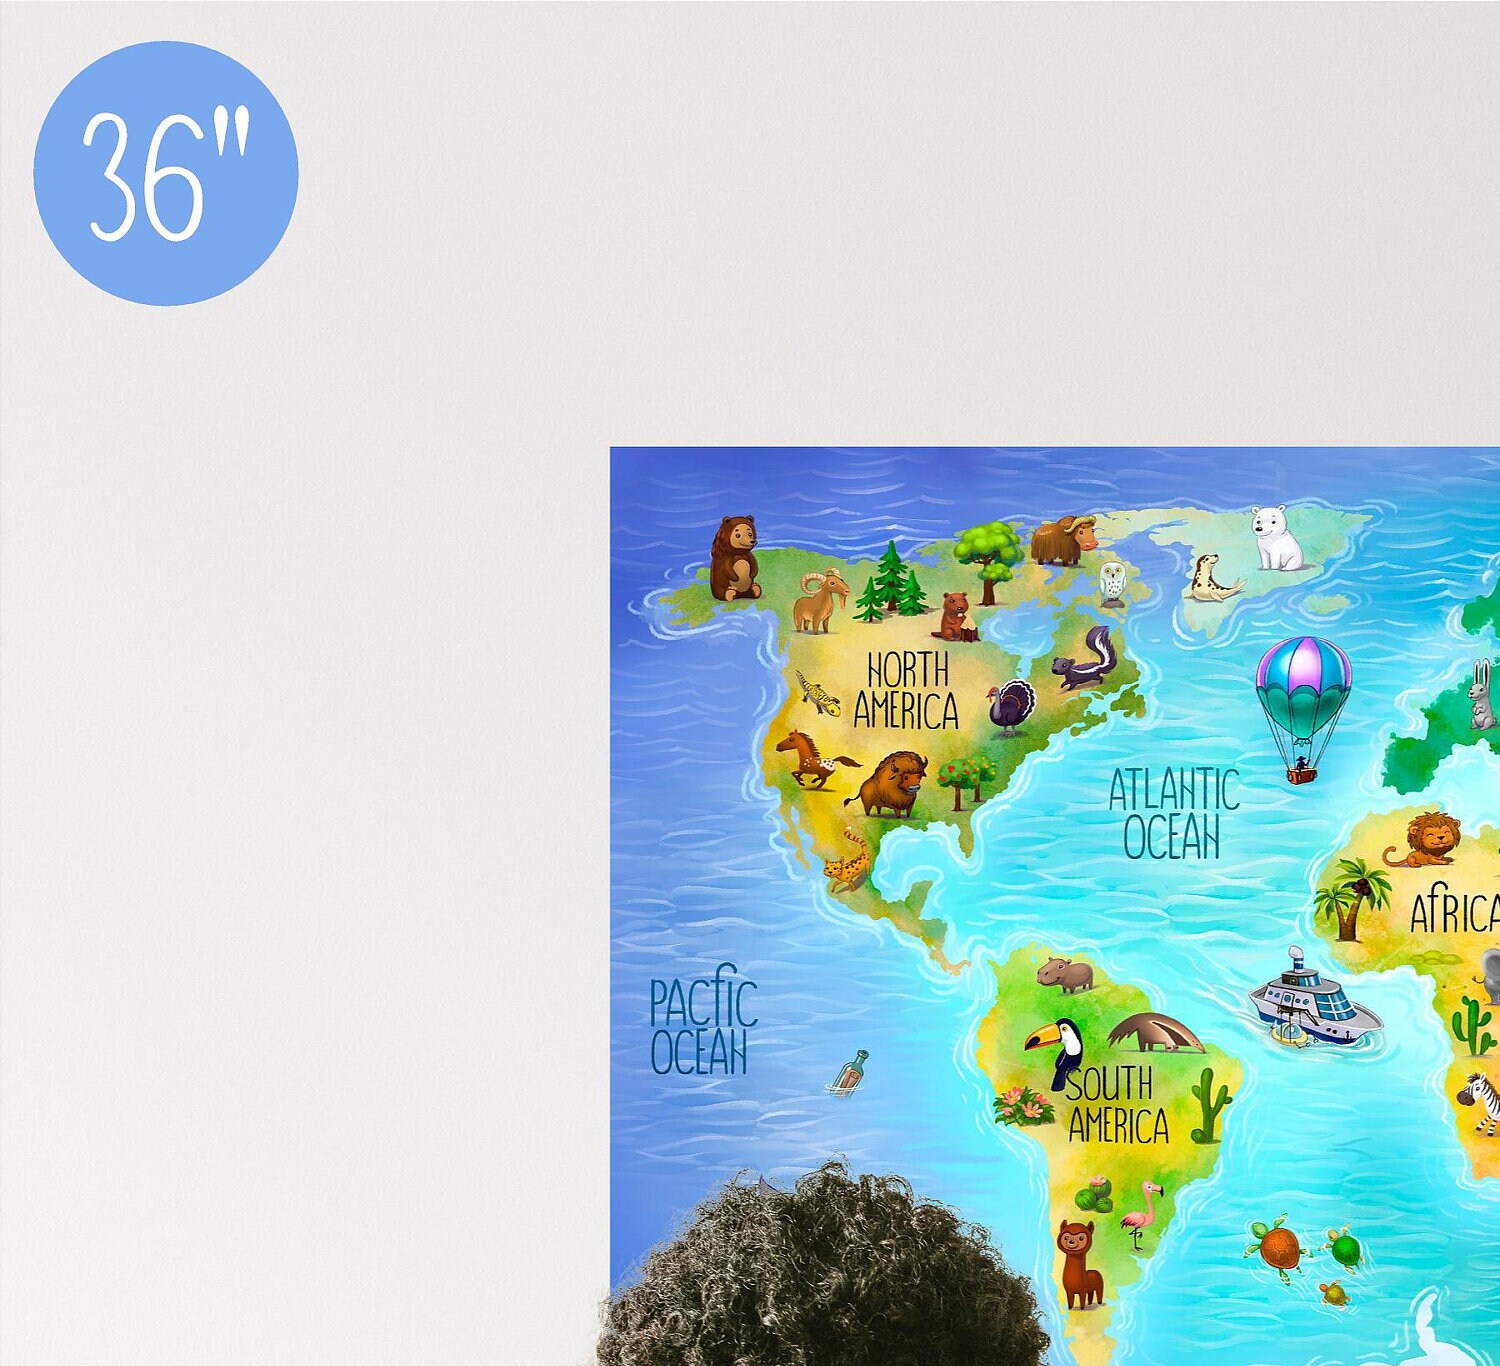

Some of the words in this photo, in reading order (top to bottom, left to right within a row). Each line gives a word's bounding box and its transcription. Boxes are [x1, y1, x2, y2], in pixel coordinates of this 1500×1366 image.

[868, 650, 949, 688] NORTH
[853, 689, 960, 730] AMERICA
[1109, 766, 1241, 811] ATLANTIC
[1123, 811, 1220, 860] OCEAN
[651, 1027, 747, 1075] OCEAN
[1065, 1065, 1153, 1101] SOUTH
[1068, 1105, 1170, 1145] AMERICA
